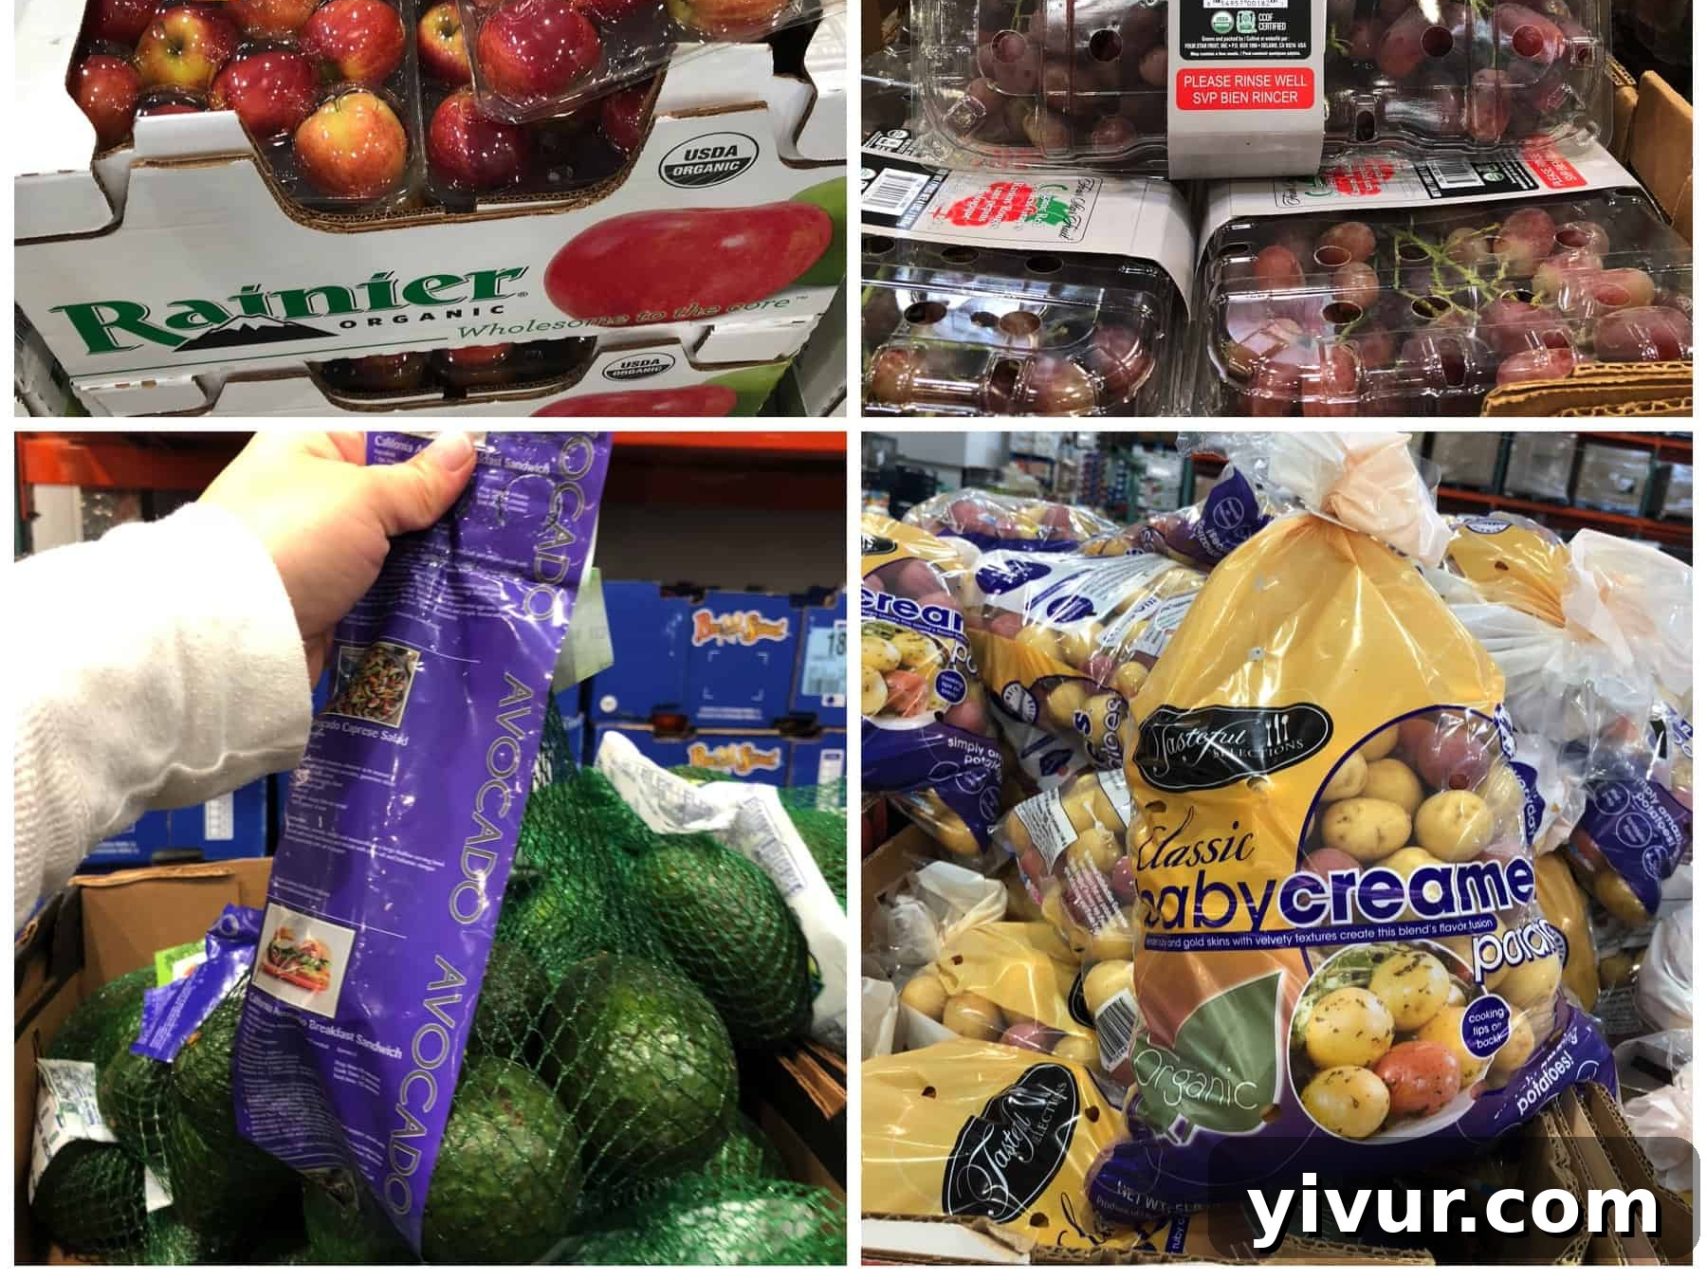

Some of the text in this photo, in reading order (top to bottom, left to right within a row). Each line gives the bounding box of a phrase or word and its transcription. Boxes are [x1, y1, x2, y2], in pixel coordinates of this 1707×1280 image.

[1258, 23, 1286, 31] CERTIFIED
[1184, 74, 1307, 88] PLEASE RINSE WELL
[1193, 91, 1298, 104] SVP BIEN RINCER
[683, 143, 739, 163] USDA
[672, 159, 741, 177] ORGANIC
[49, 265, 530, 356] Rainier
[339, 304, 505, 330] ORGANIC
[636, 306, 666, 321] to
[673, 301, 719, 320] the
[726, 297, 792, 315] core
[620, 357, 661, 371] USDA
[503, 456, 550, 474] Sandwich
[523, 432, 598, 620] OCADO
[379, 728, 408, 747] Salad
[947, 737, 985, 755] simply
[1150, 719, 1246, 776] Tasteful
[449, 672, 534, 925] AVOCADO
[1137, 807, 1257, 872] Classic
[1183, 935, 1206, 949] gold
[1206, 935, 1231, 947] skins
[1232, 934, 1253, 947] with
[1254, 933, 1293, 948] velvety
[1294, 928, 1338, 944] textures
[1338, 927, 1375, 941] create
[1377, 924, 1397, 938] this
[1398, 922, 1438, 937] blend's
[1439, 920, 1469, 934] flavor
[1469, 918, 1494, 932] fusion
[1468, 1007, 1505, 1024] cooking
[308, 1018, 403, 1060] Breakfast Sandwich
[1472, 1023, 1490, 1037] tips
[384, 954, 468, 1216] AVOCADO
[1133, 1049, 1259, 1112] Organic
[1516, 1049, 1575, 1117] potatoes!
